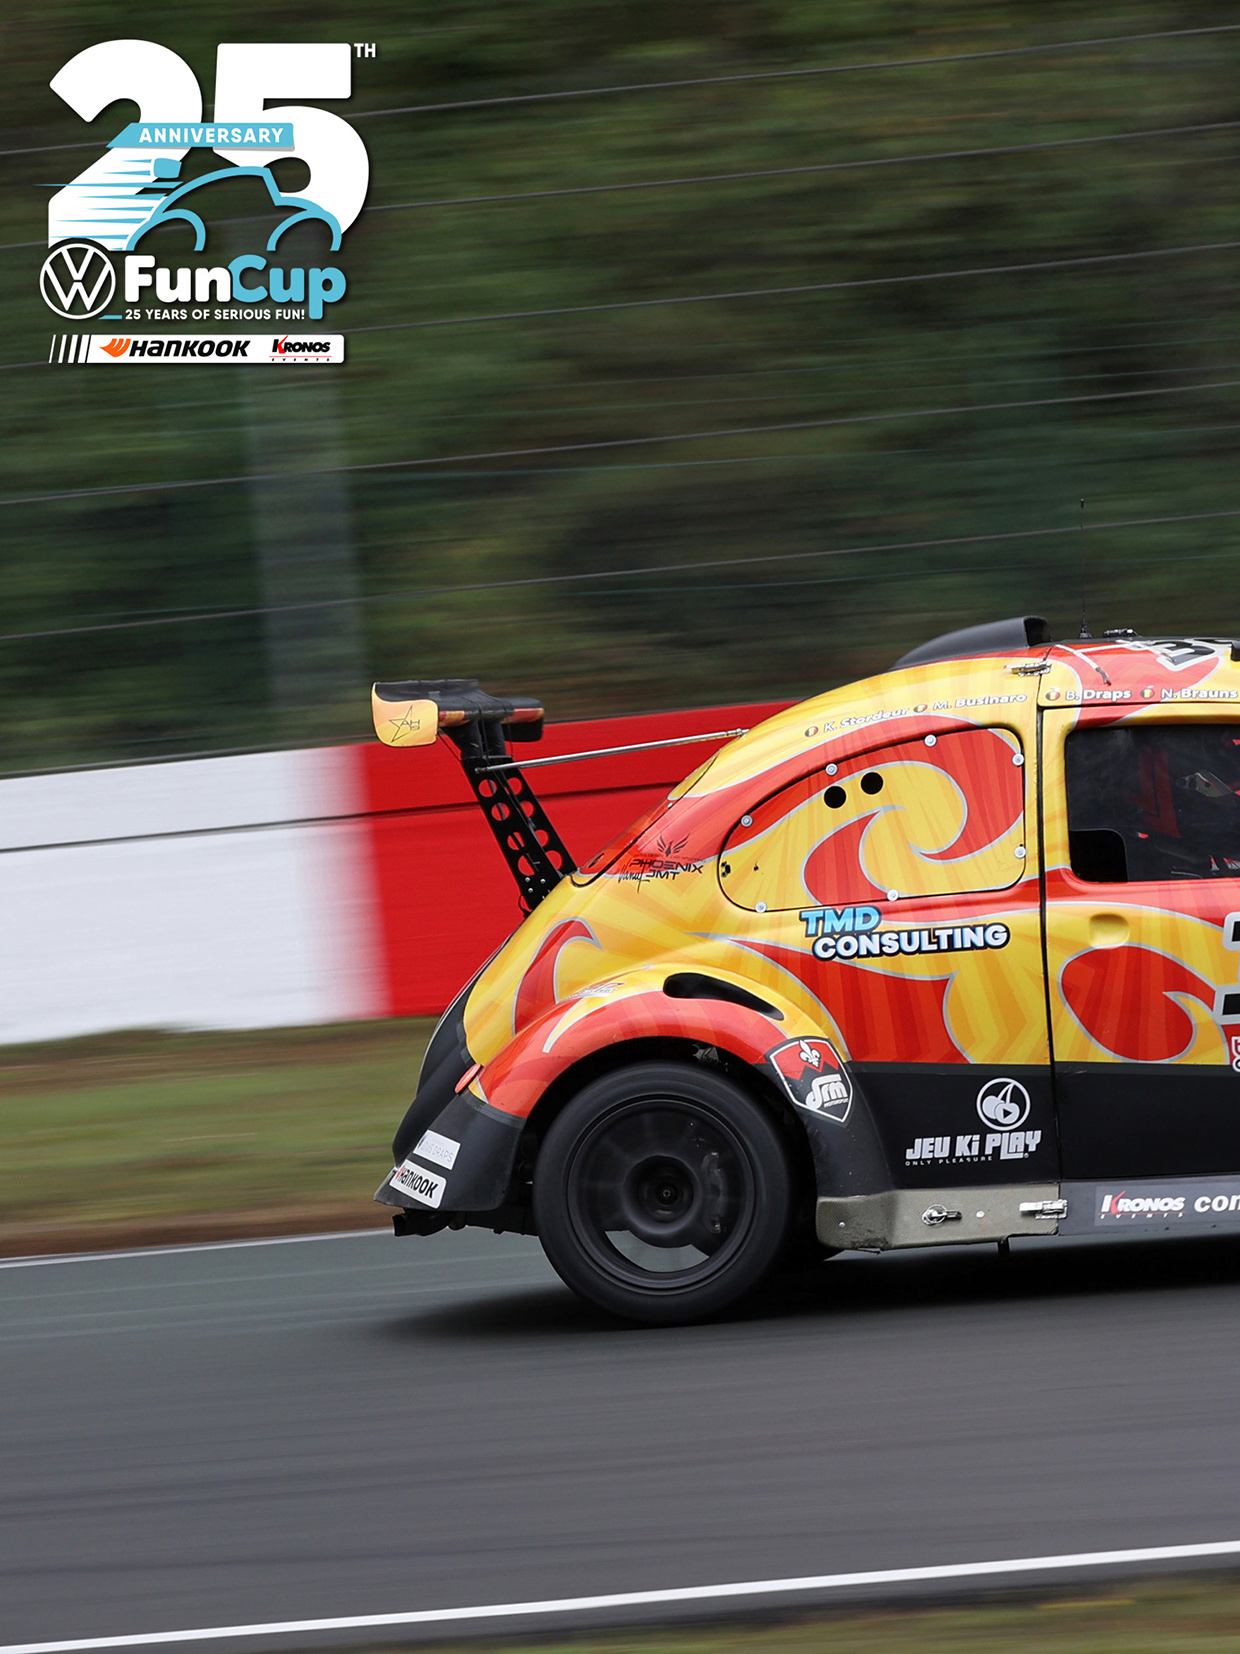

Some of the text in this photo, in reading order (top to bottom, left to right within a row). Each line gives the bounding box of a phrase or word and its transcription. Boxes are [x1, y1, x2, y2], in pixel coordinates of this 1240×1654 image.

[1065, 688, 1132, 703] B. Draps
[1161, 688, 1239, 699] N. Brauns
[933, 694, 1027, 711] M. Businaro
[824, 707, 909, 732] K. Stordeur
[629, 858, 704, 874] PHOENIX
[646, 869, 680, 880] JMT
[801, 906, 880, 935] TMD
[814, 925, 1008, 958] CONSULTING
[906, 1137, 950, 1160] JEU
[984, 1130, 1042, 1160] PLAY
[939, 1155, 993, 1165] PLEASURE
[1101, 1190, 1185, 1213] KRONOS
